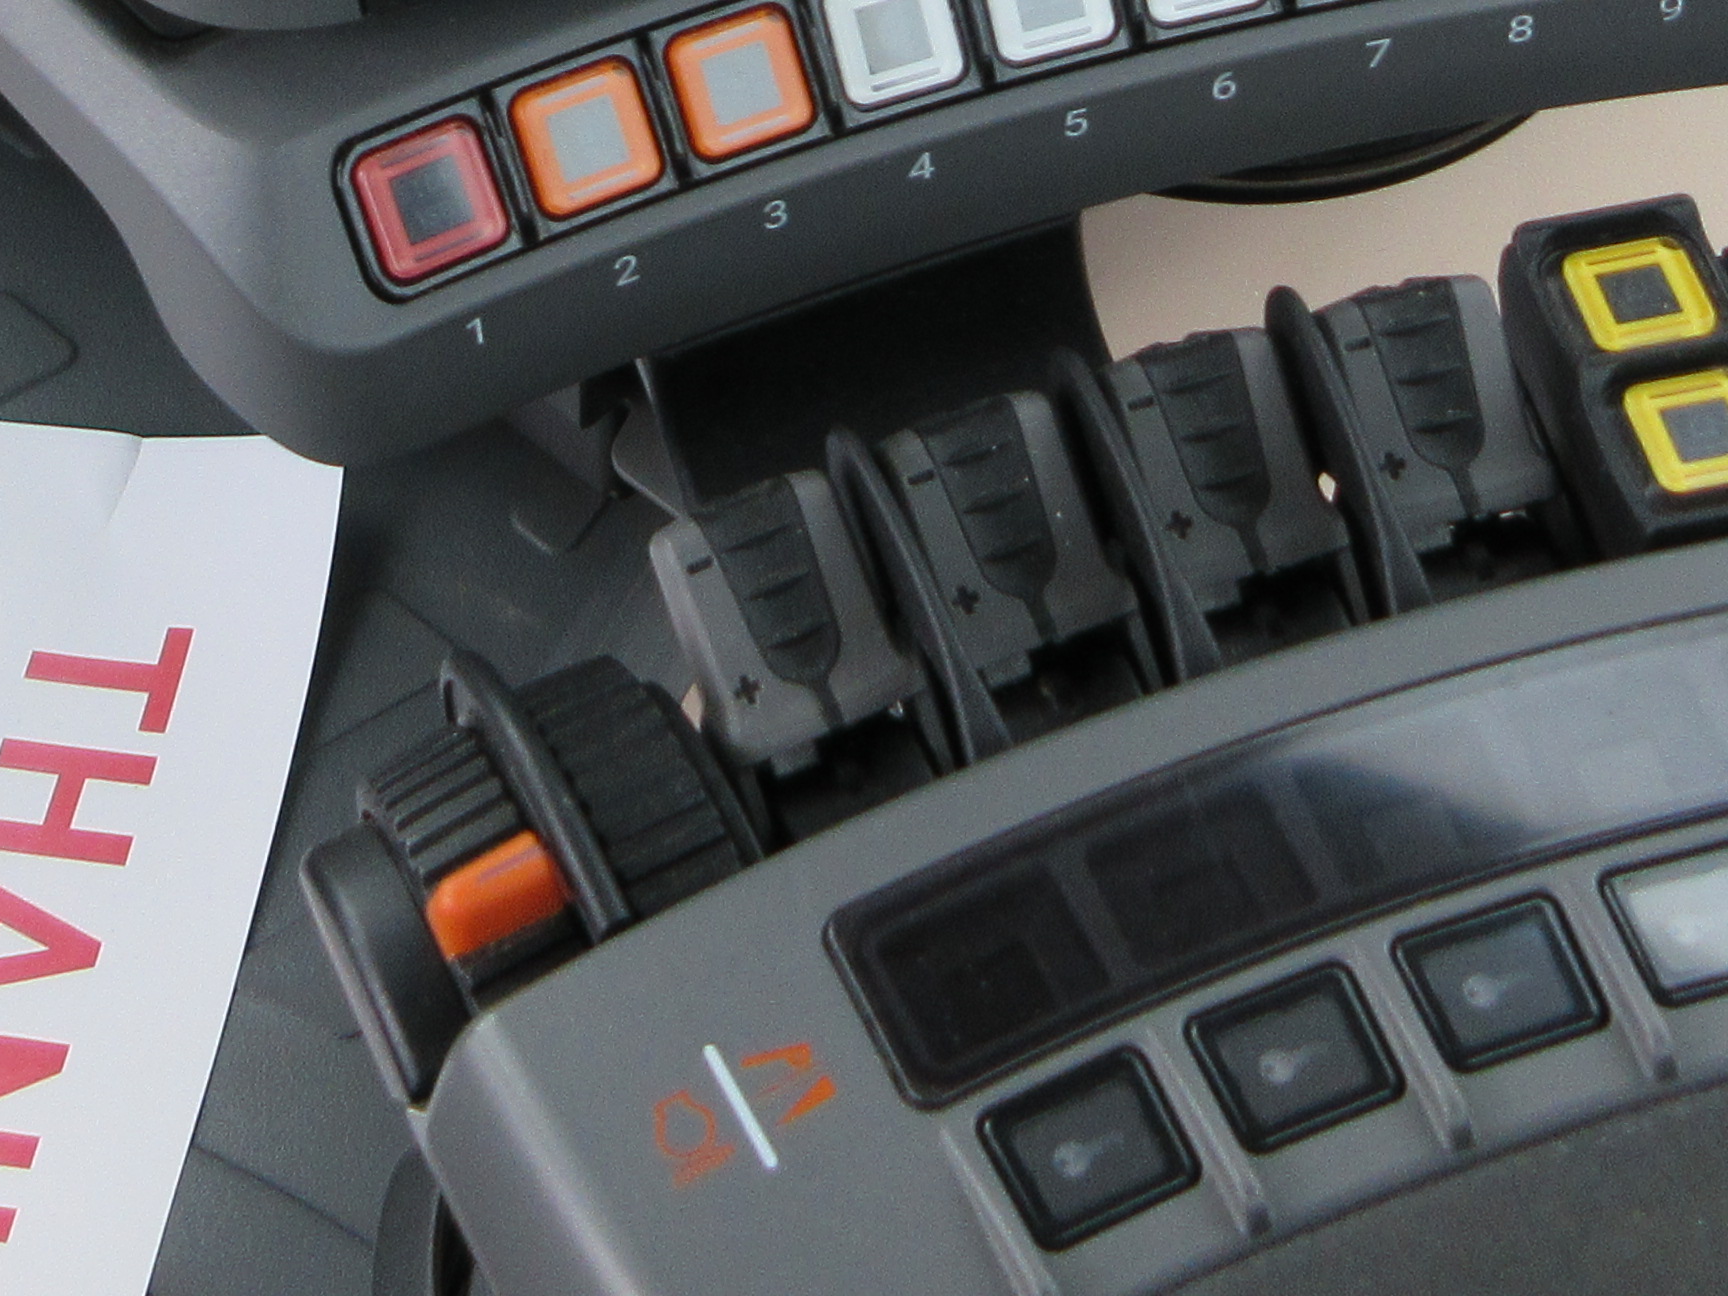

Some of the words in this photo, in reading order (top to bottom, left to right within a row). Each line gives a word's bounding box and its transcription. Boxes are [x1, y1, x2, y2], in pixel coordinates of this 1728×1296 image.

[1507, 15, 1534, 43] 8
[1365, 38, 1391, 68] 7
[1212, 72, 1236, 100] 6
[1064, 108, 1088, 137] 5
[909, 152, 935, 179] 4
[764, 200, 787, 229] 3
[614, 255, 639, 286] 2
[466, 318, 484, 344] 1
